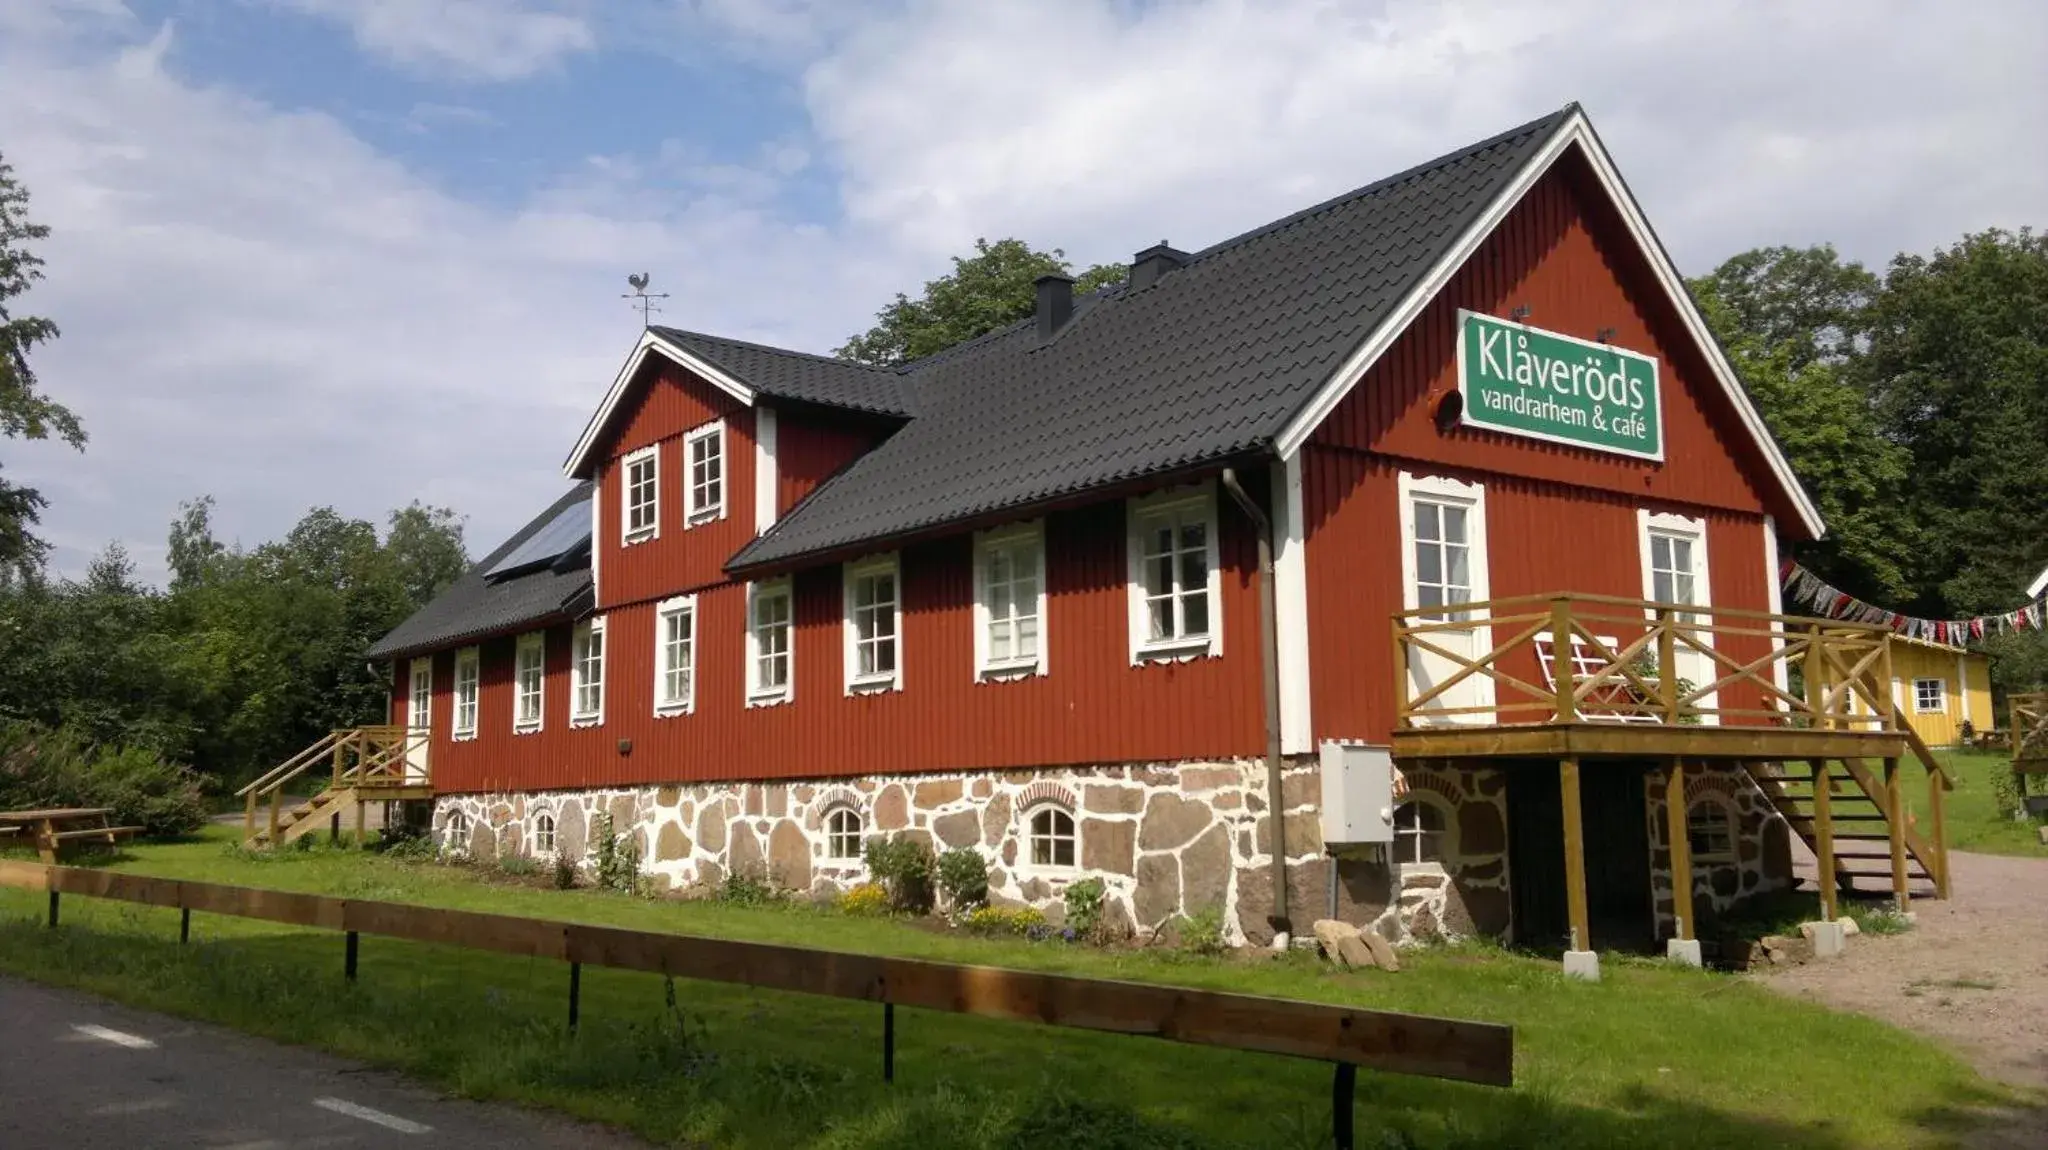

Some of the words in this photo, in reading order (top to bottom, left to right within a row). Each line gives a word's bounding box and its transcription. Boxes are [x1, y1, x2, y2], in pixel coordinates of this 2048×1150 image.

[1478, 325, 1645, 410] Klåveröds
[1481, 388, 1587, 427] vandrarhem
[1592, 404, 1608, 431] &
[1612, 412, 1647, 439] café
